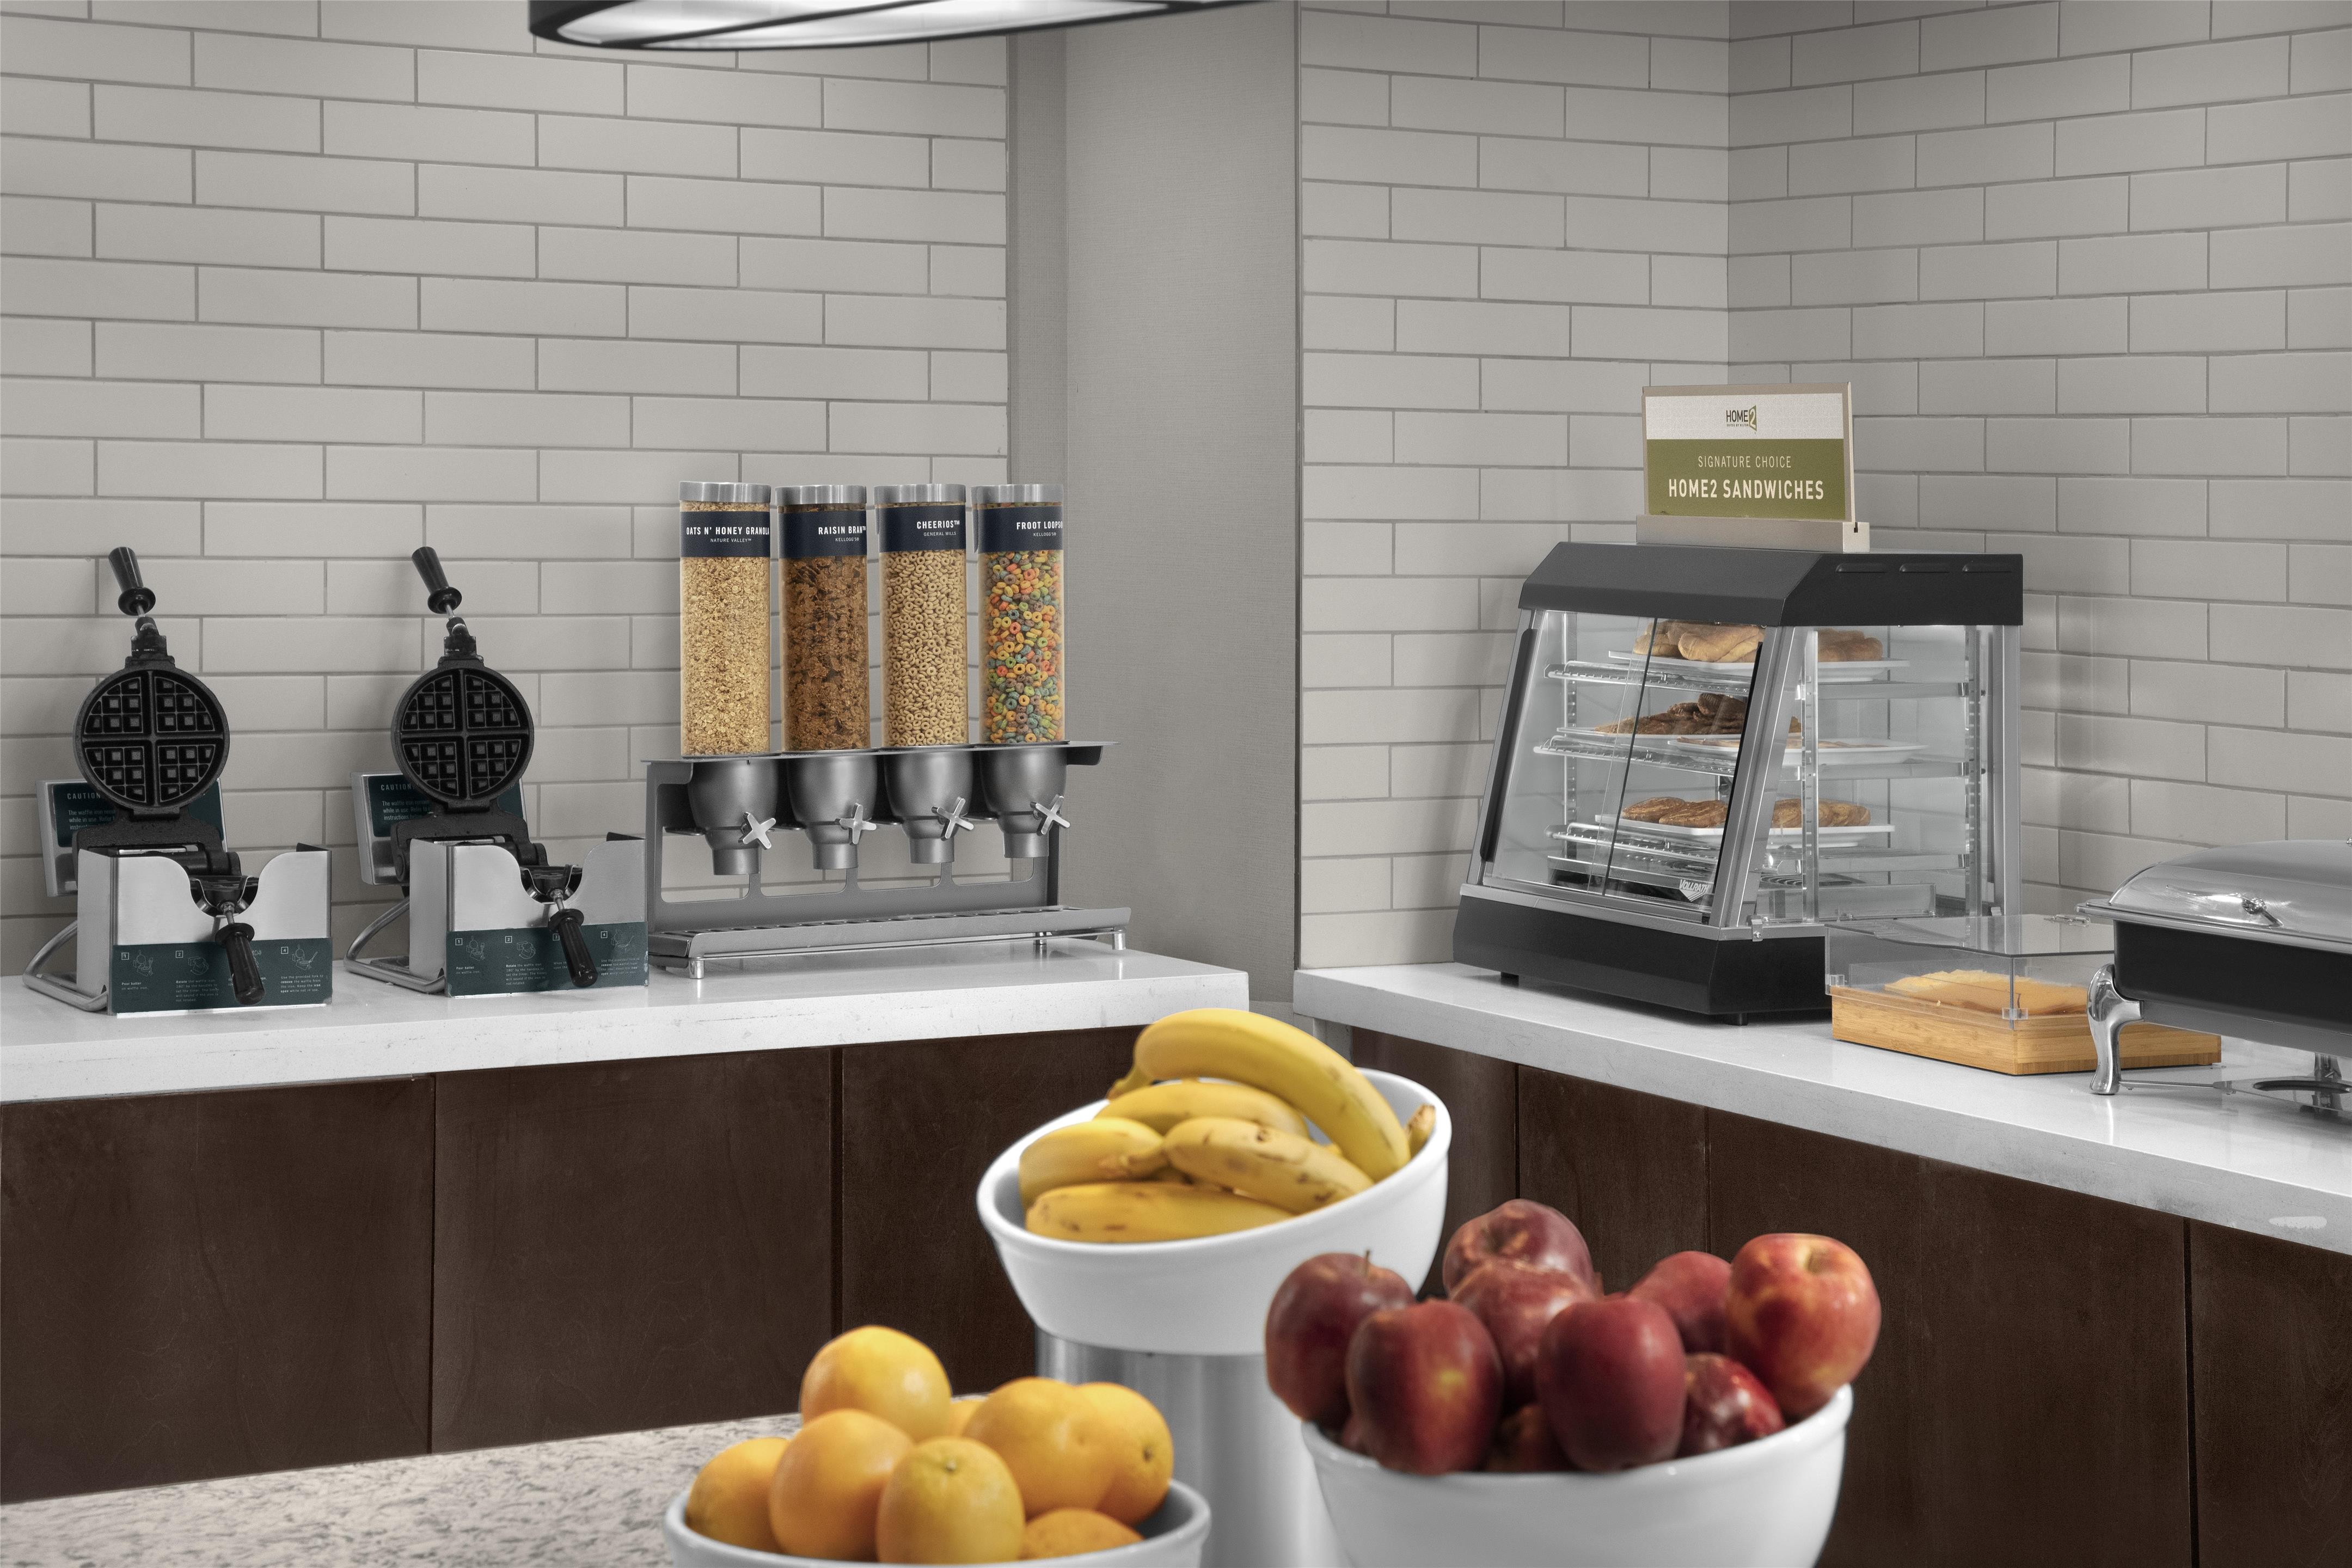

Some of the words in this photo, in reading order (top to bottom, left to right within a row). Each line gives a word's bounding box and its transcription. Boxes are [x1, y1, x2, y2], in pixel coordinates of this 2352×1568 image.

[1698, 456, 1751, 467] SIGNATURE
[1755, 456, 1791, 468] CHOICE
[1669, 479, 1717, 498] HOME2
[1723, 479, 1824, 500] SANDWICHES
[686, 526, 701, 535] OATS
[704, 526, 712, 535] N'
[715, 526, 743, 535] HONEY
[746, 526, 769, 535] GRANOLA
[818, 526, 845, 535] RAISIN
[1016, 521, 1041, 530] FROOT
[1679, 879, 1711, 893] VOLLRATH
